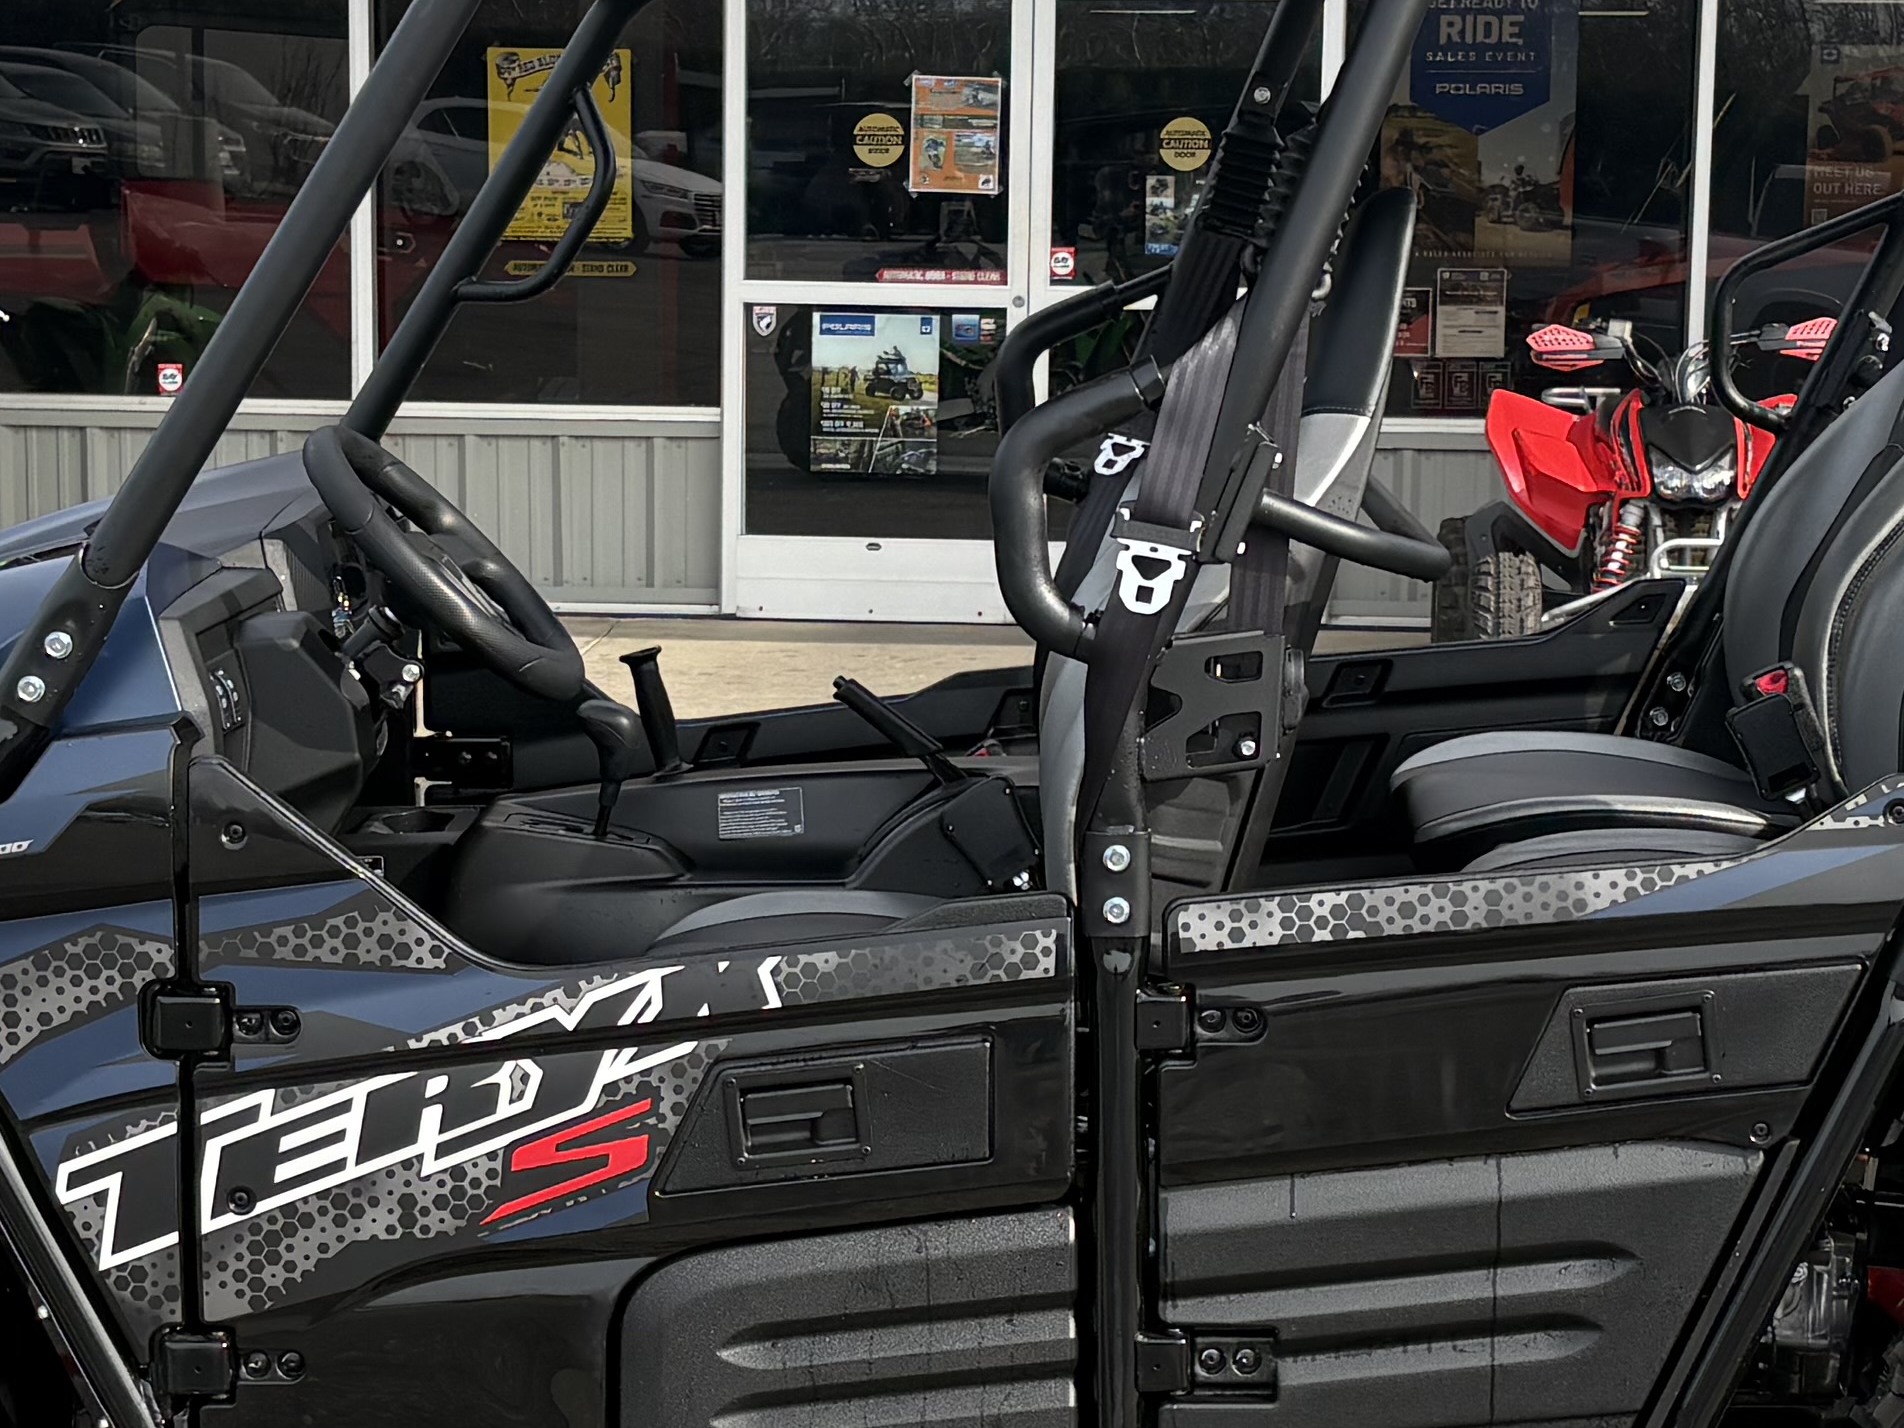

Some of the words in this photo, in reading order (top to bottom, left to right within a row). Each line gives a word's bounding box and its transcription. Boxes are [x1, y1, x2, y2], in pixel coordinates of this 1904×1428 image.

[1439, 14, 1525, 46] RIDE
[1425, 51, 1477, 63] SALES
[1485, 51, 1537, 63] EVENT
[1434, 83, 1525, 96] POLARIS
[855, 135, 903, 145] CAUTION
[1162, 139, 1209, 149] CAUTION
[1812, 182, 1841, 194] OUT
[821, 322, 872, 331] POLARIS
